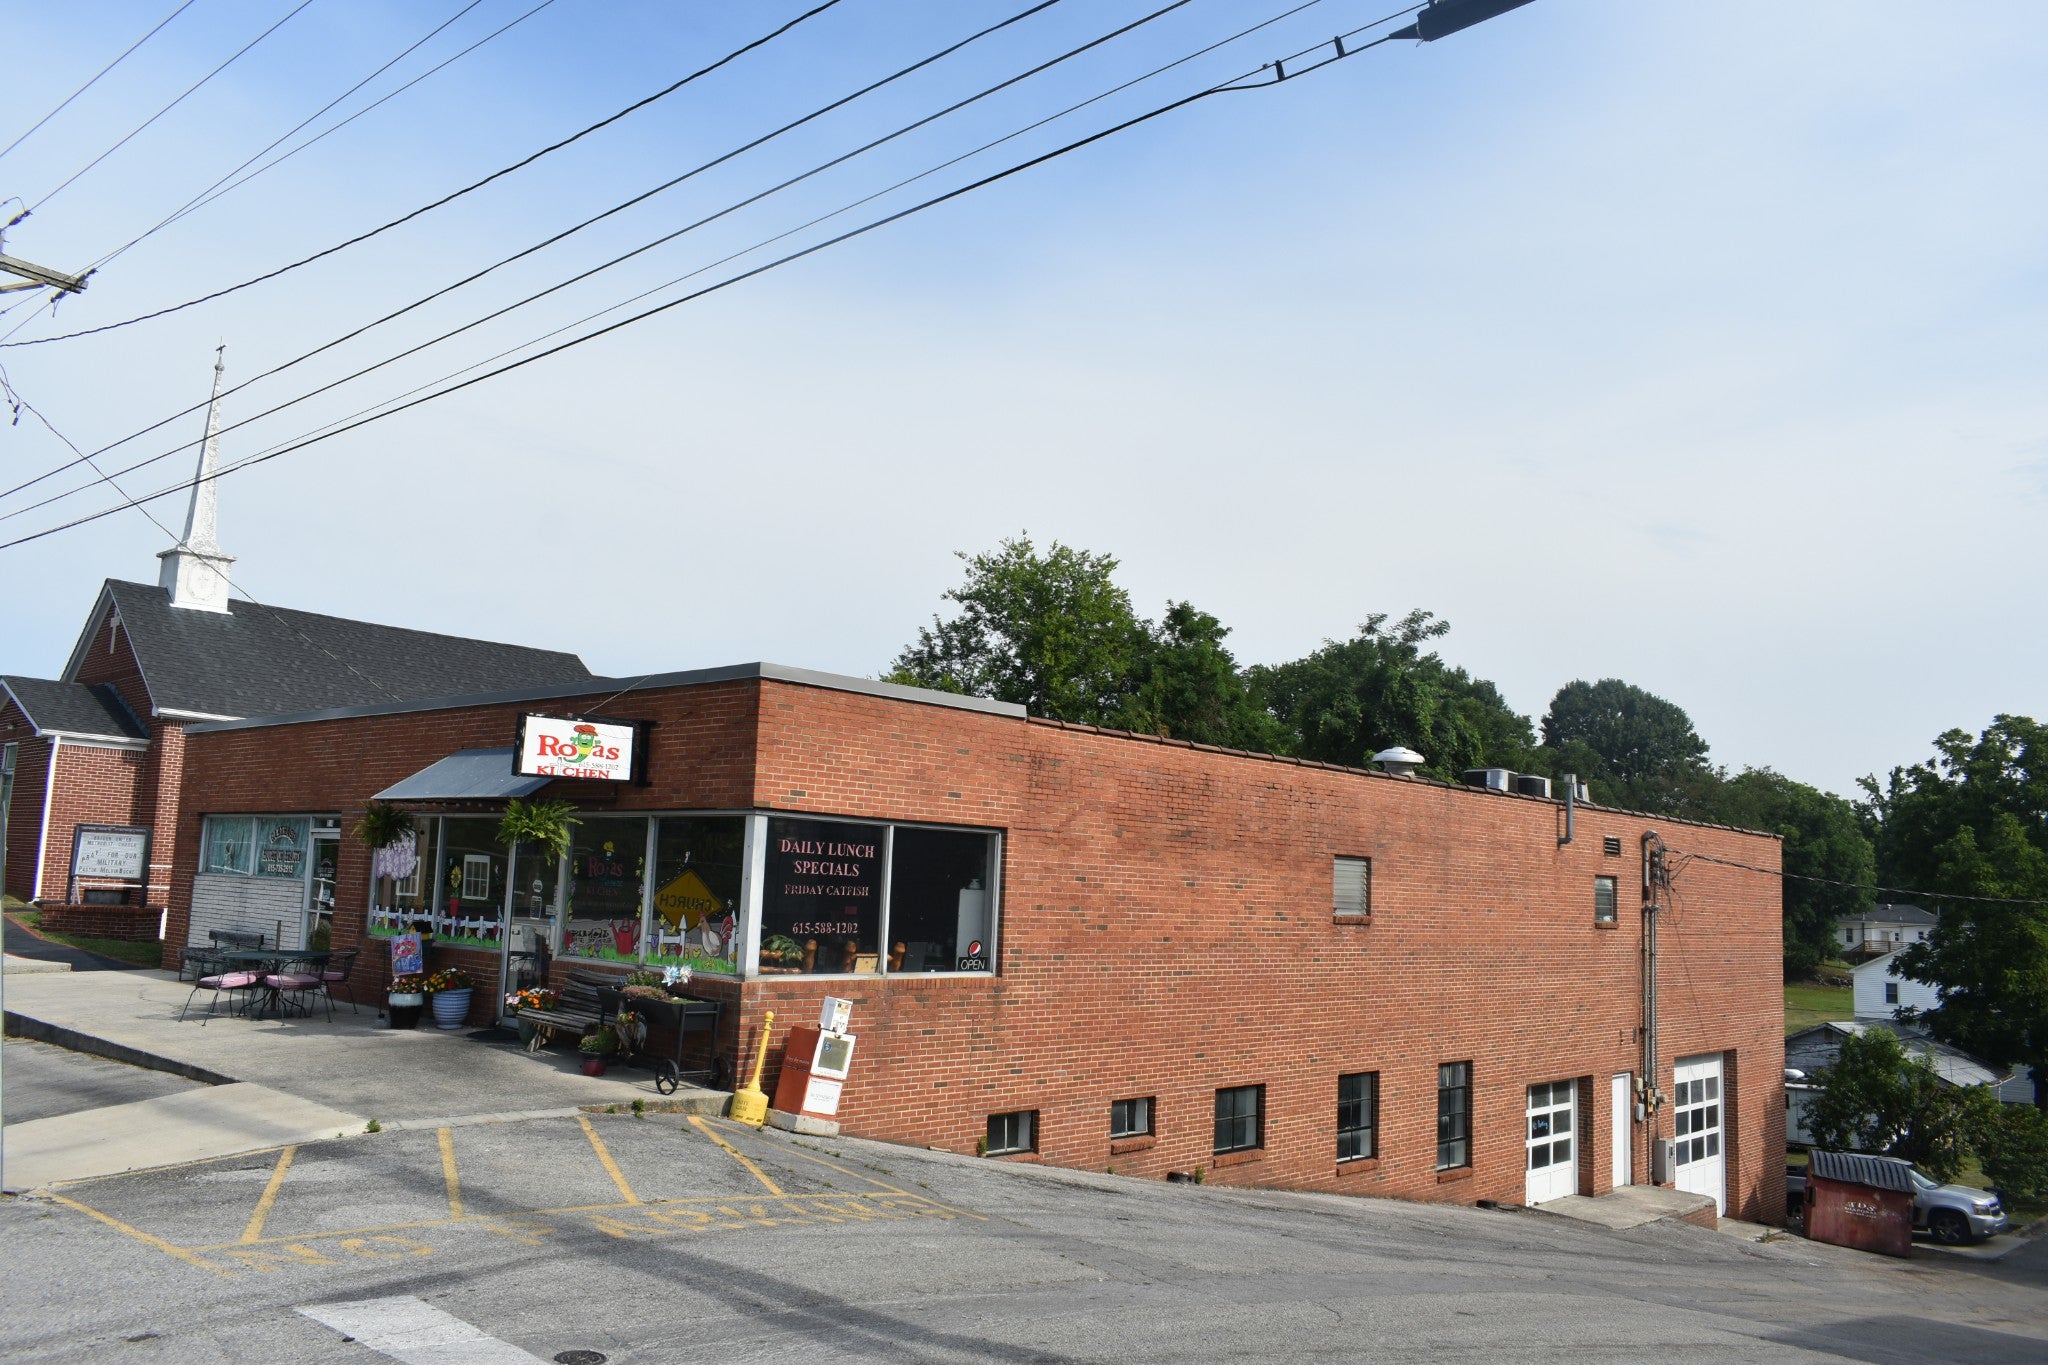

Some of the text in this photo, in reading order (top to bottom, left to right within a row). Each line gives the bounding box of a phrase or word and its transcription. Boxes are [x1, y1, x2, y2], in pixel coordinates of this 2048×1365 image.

[780, 839, 875, 858] DAILY LUNCH
[124, 852, 137, 860] OUR
[794, 860, 860, 877] SPECIALS
[784, 884, 870, 896] FRIDAY CATFISH
[792, 921, 859, 934] 615-588-1202
[960, 958, 986, 971] OPEN
